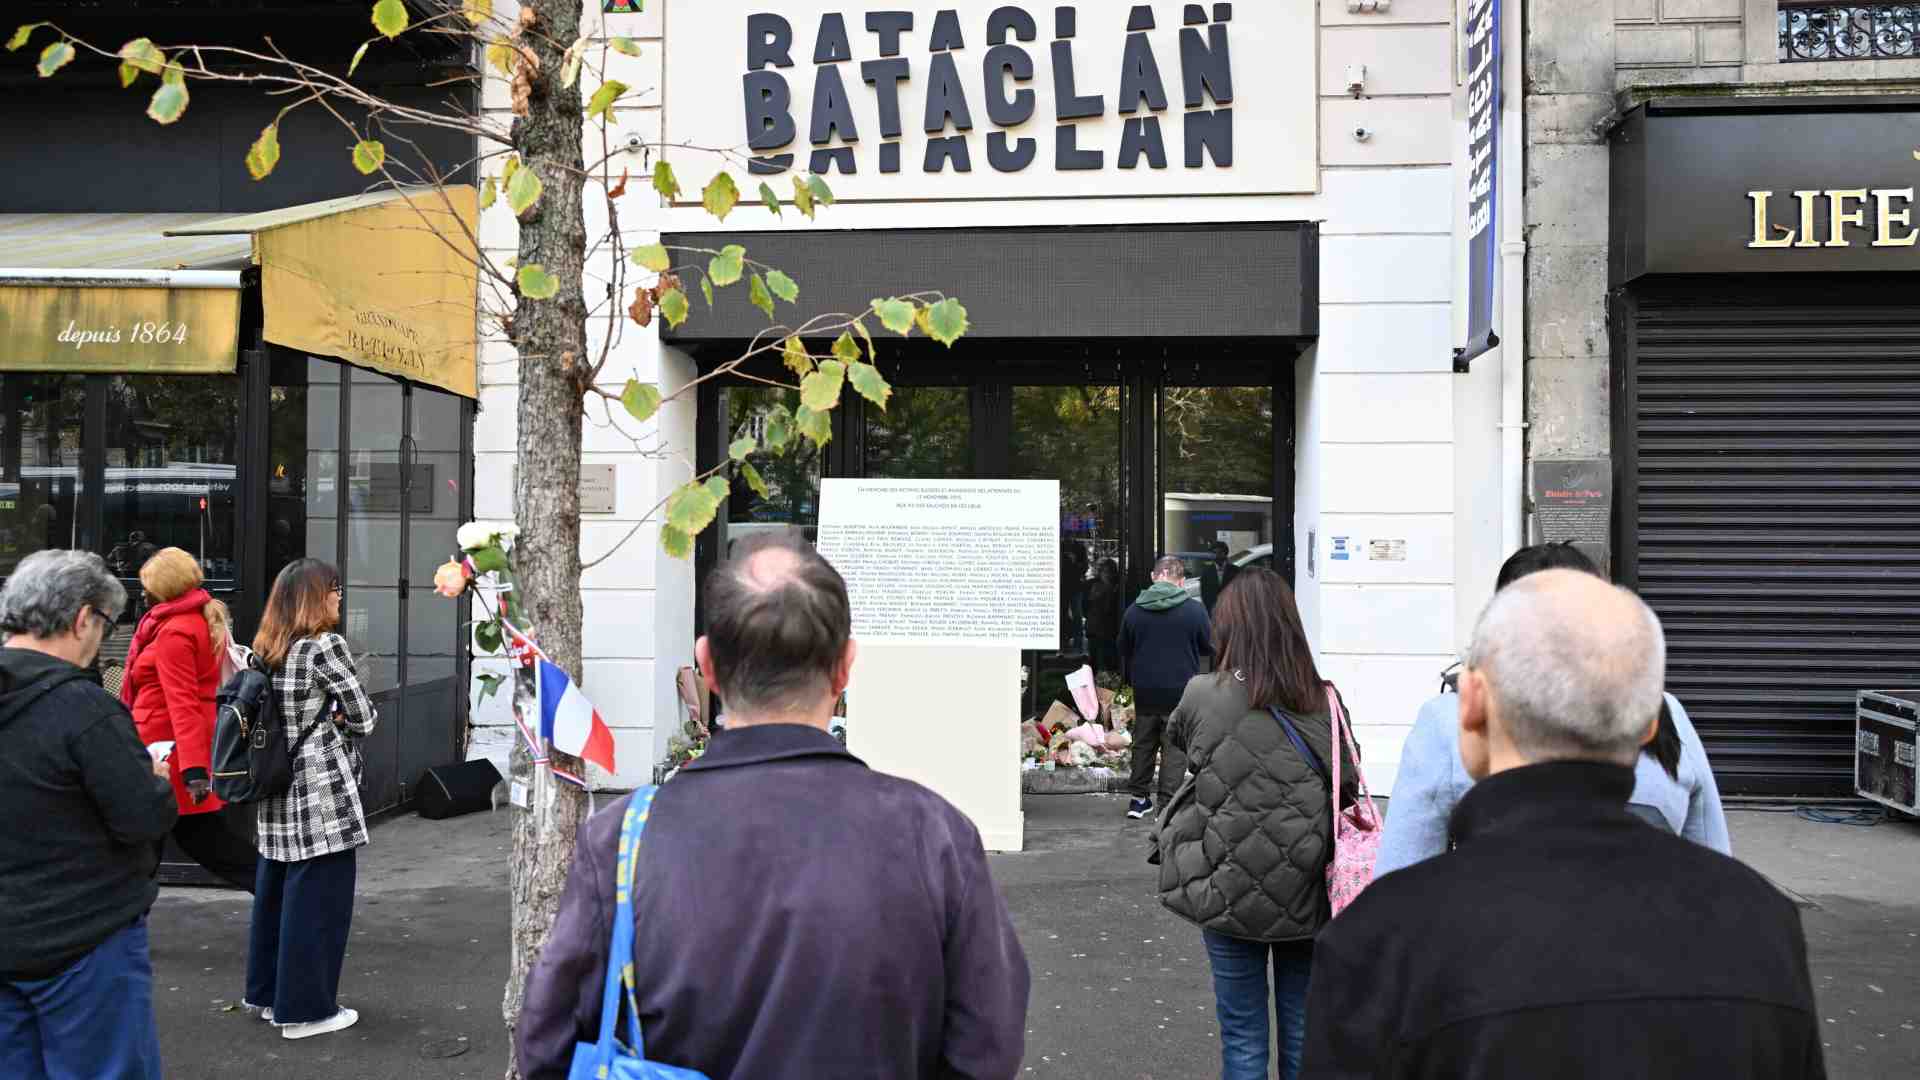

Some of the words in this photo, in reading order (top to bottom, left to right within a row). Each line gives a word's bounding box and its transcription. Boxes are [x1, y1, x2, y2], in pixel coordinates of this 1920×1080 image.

[744, 3, 1233, 173] BATACLAN
[1748, 188, 1919, 248] LIFE
[57, 320, 121, 349] depuis
[130, 321, 187, 344] 1864
